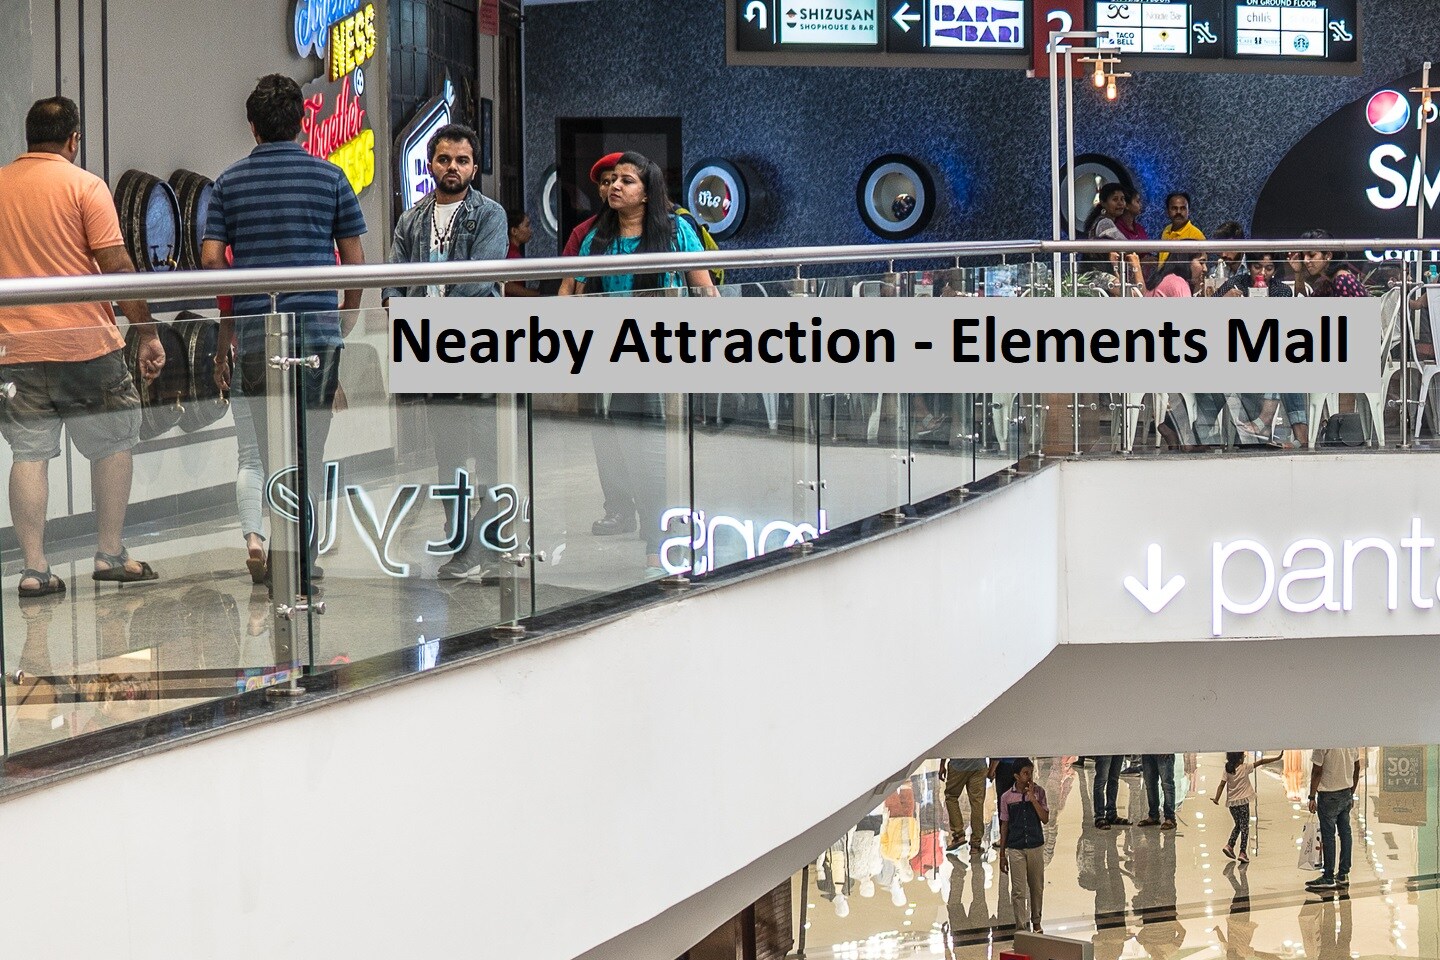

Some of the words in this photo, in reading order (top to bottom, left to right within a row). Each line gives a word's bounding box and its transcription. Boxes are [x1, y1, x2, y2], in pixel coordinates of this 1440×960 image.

[1294, 0, 1317, 8] FLOOR
[799, 8, 875, 21] SHIZUSAN
[800, 23, 850, 31] SHOPHOUSE
[1046, 10, 1073, 53] 2
[1116, 38, 1135, 46] BELL
